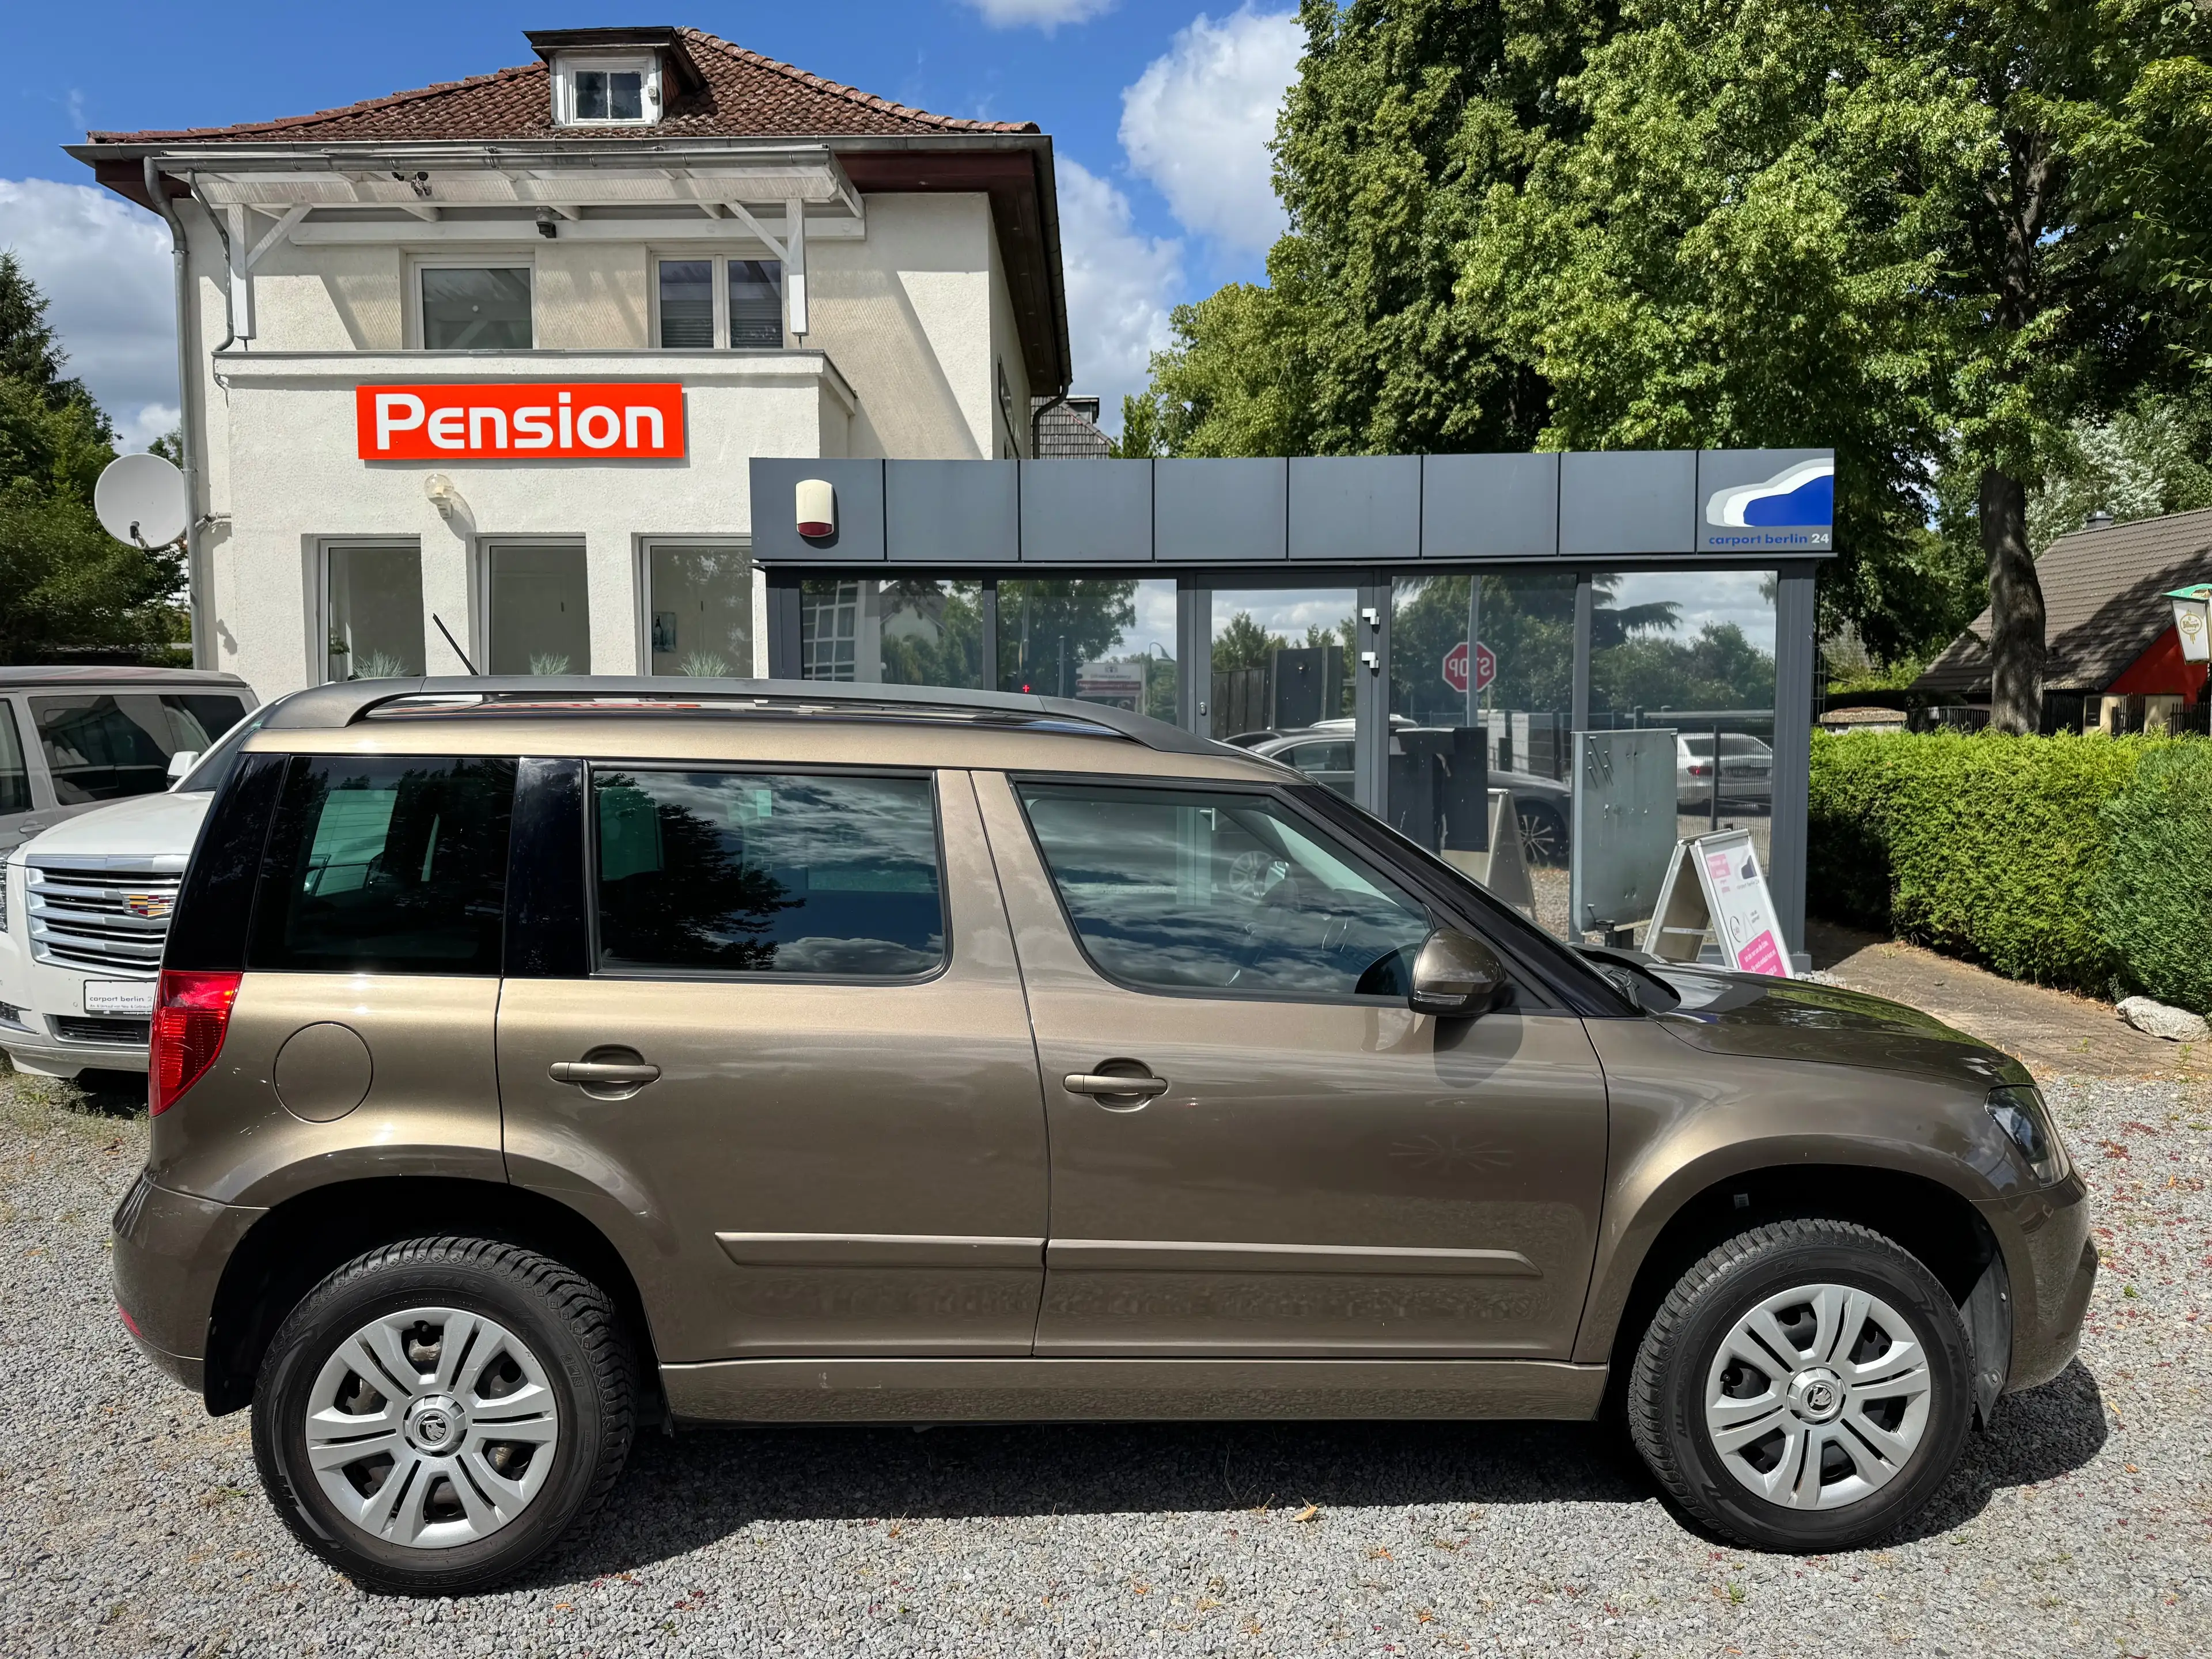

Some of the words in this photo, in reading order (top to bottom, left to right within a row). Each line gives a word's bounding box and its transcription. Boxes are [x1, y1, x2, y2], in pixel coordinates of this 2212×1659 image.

[375, 392, 664, 450] Pension
[1709, 535, 1762, 546] carport
[1765, 533, 1808, 544] berlin
[1811, 533, 1829, 544] 24
